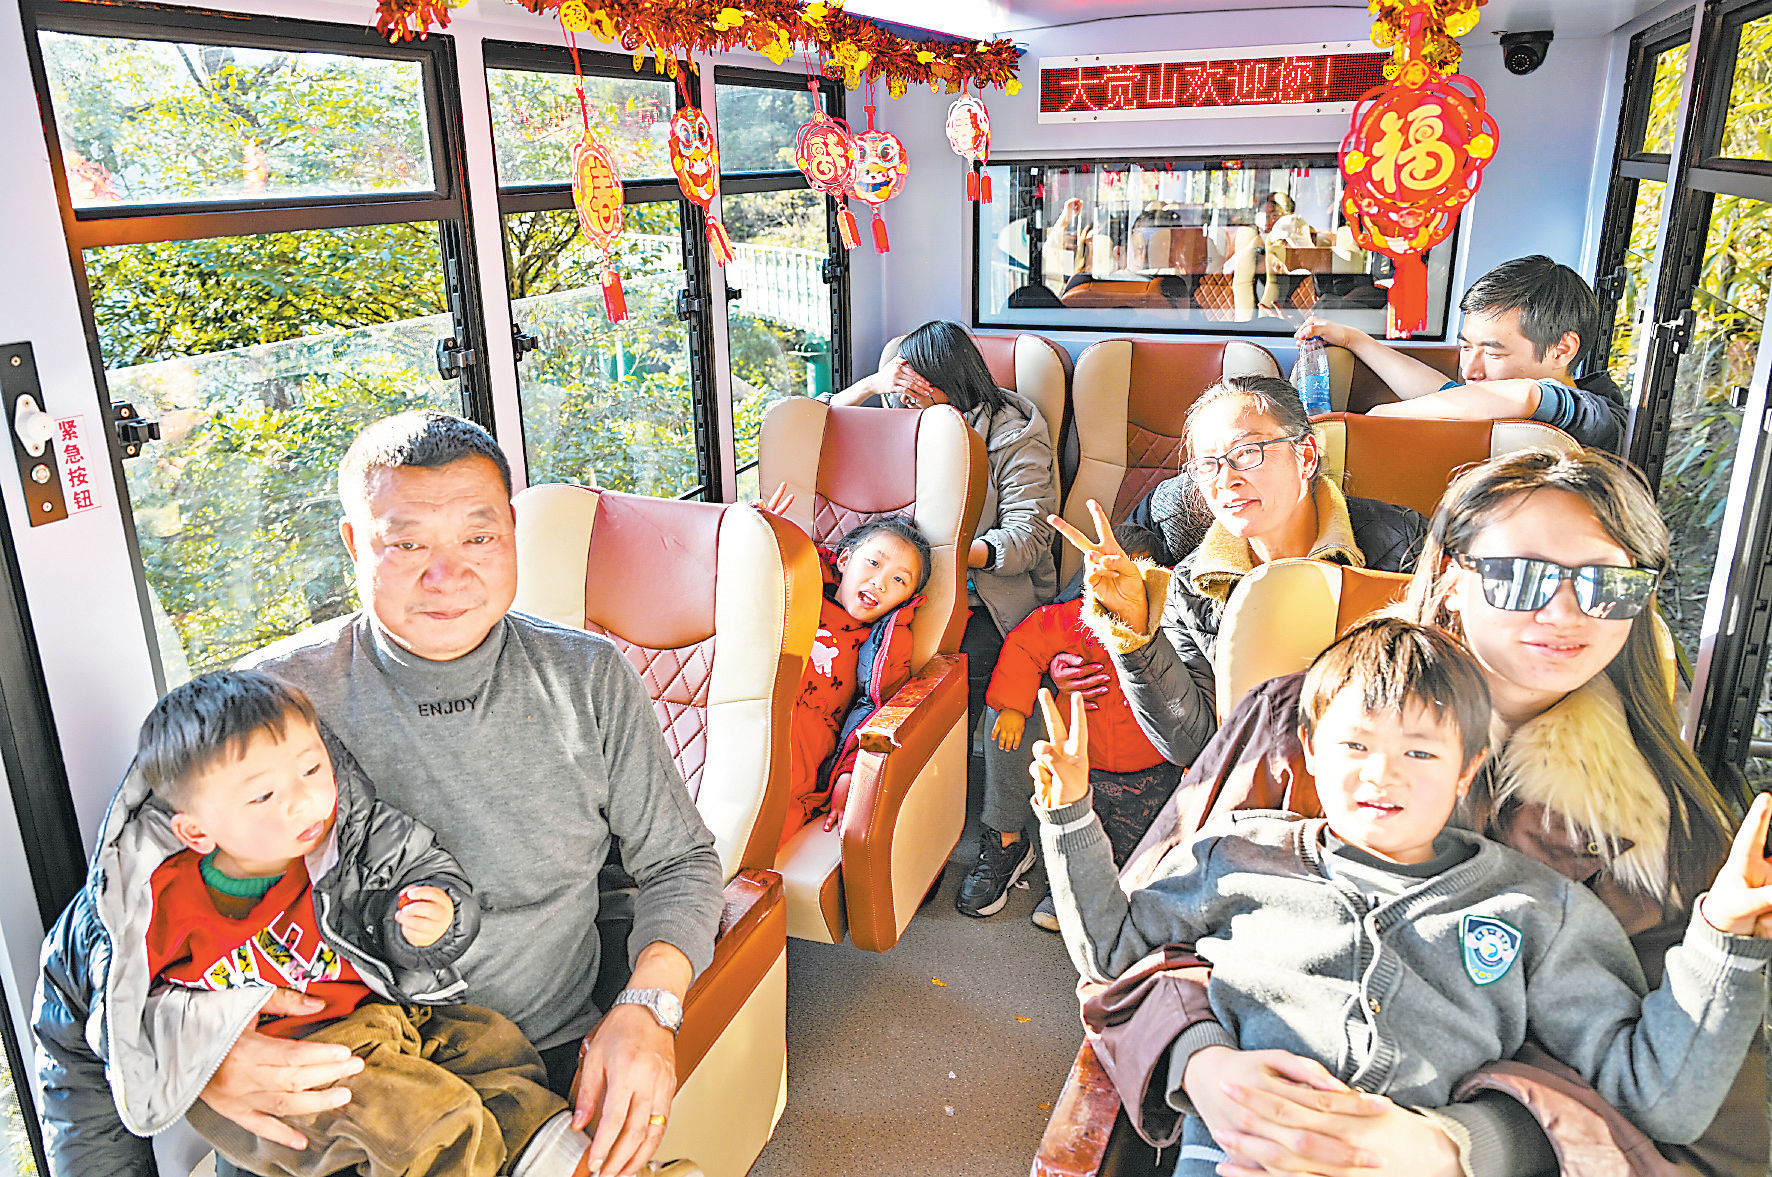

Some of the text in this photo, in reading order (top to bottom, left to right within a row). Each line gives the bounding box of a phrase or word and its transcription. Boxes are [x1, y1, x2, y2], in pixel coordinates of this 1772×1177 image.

[1060, 56, 1331, 112] 大觉山欢迎您！
[1371, 104, 1456, 193] 福
[58, 420, 94, 510] 紧急按钮
[418, 695, 478, 717] ENJOY
